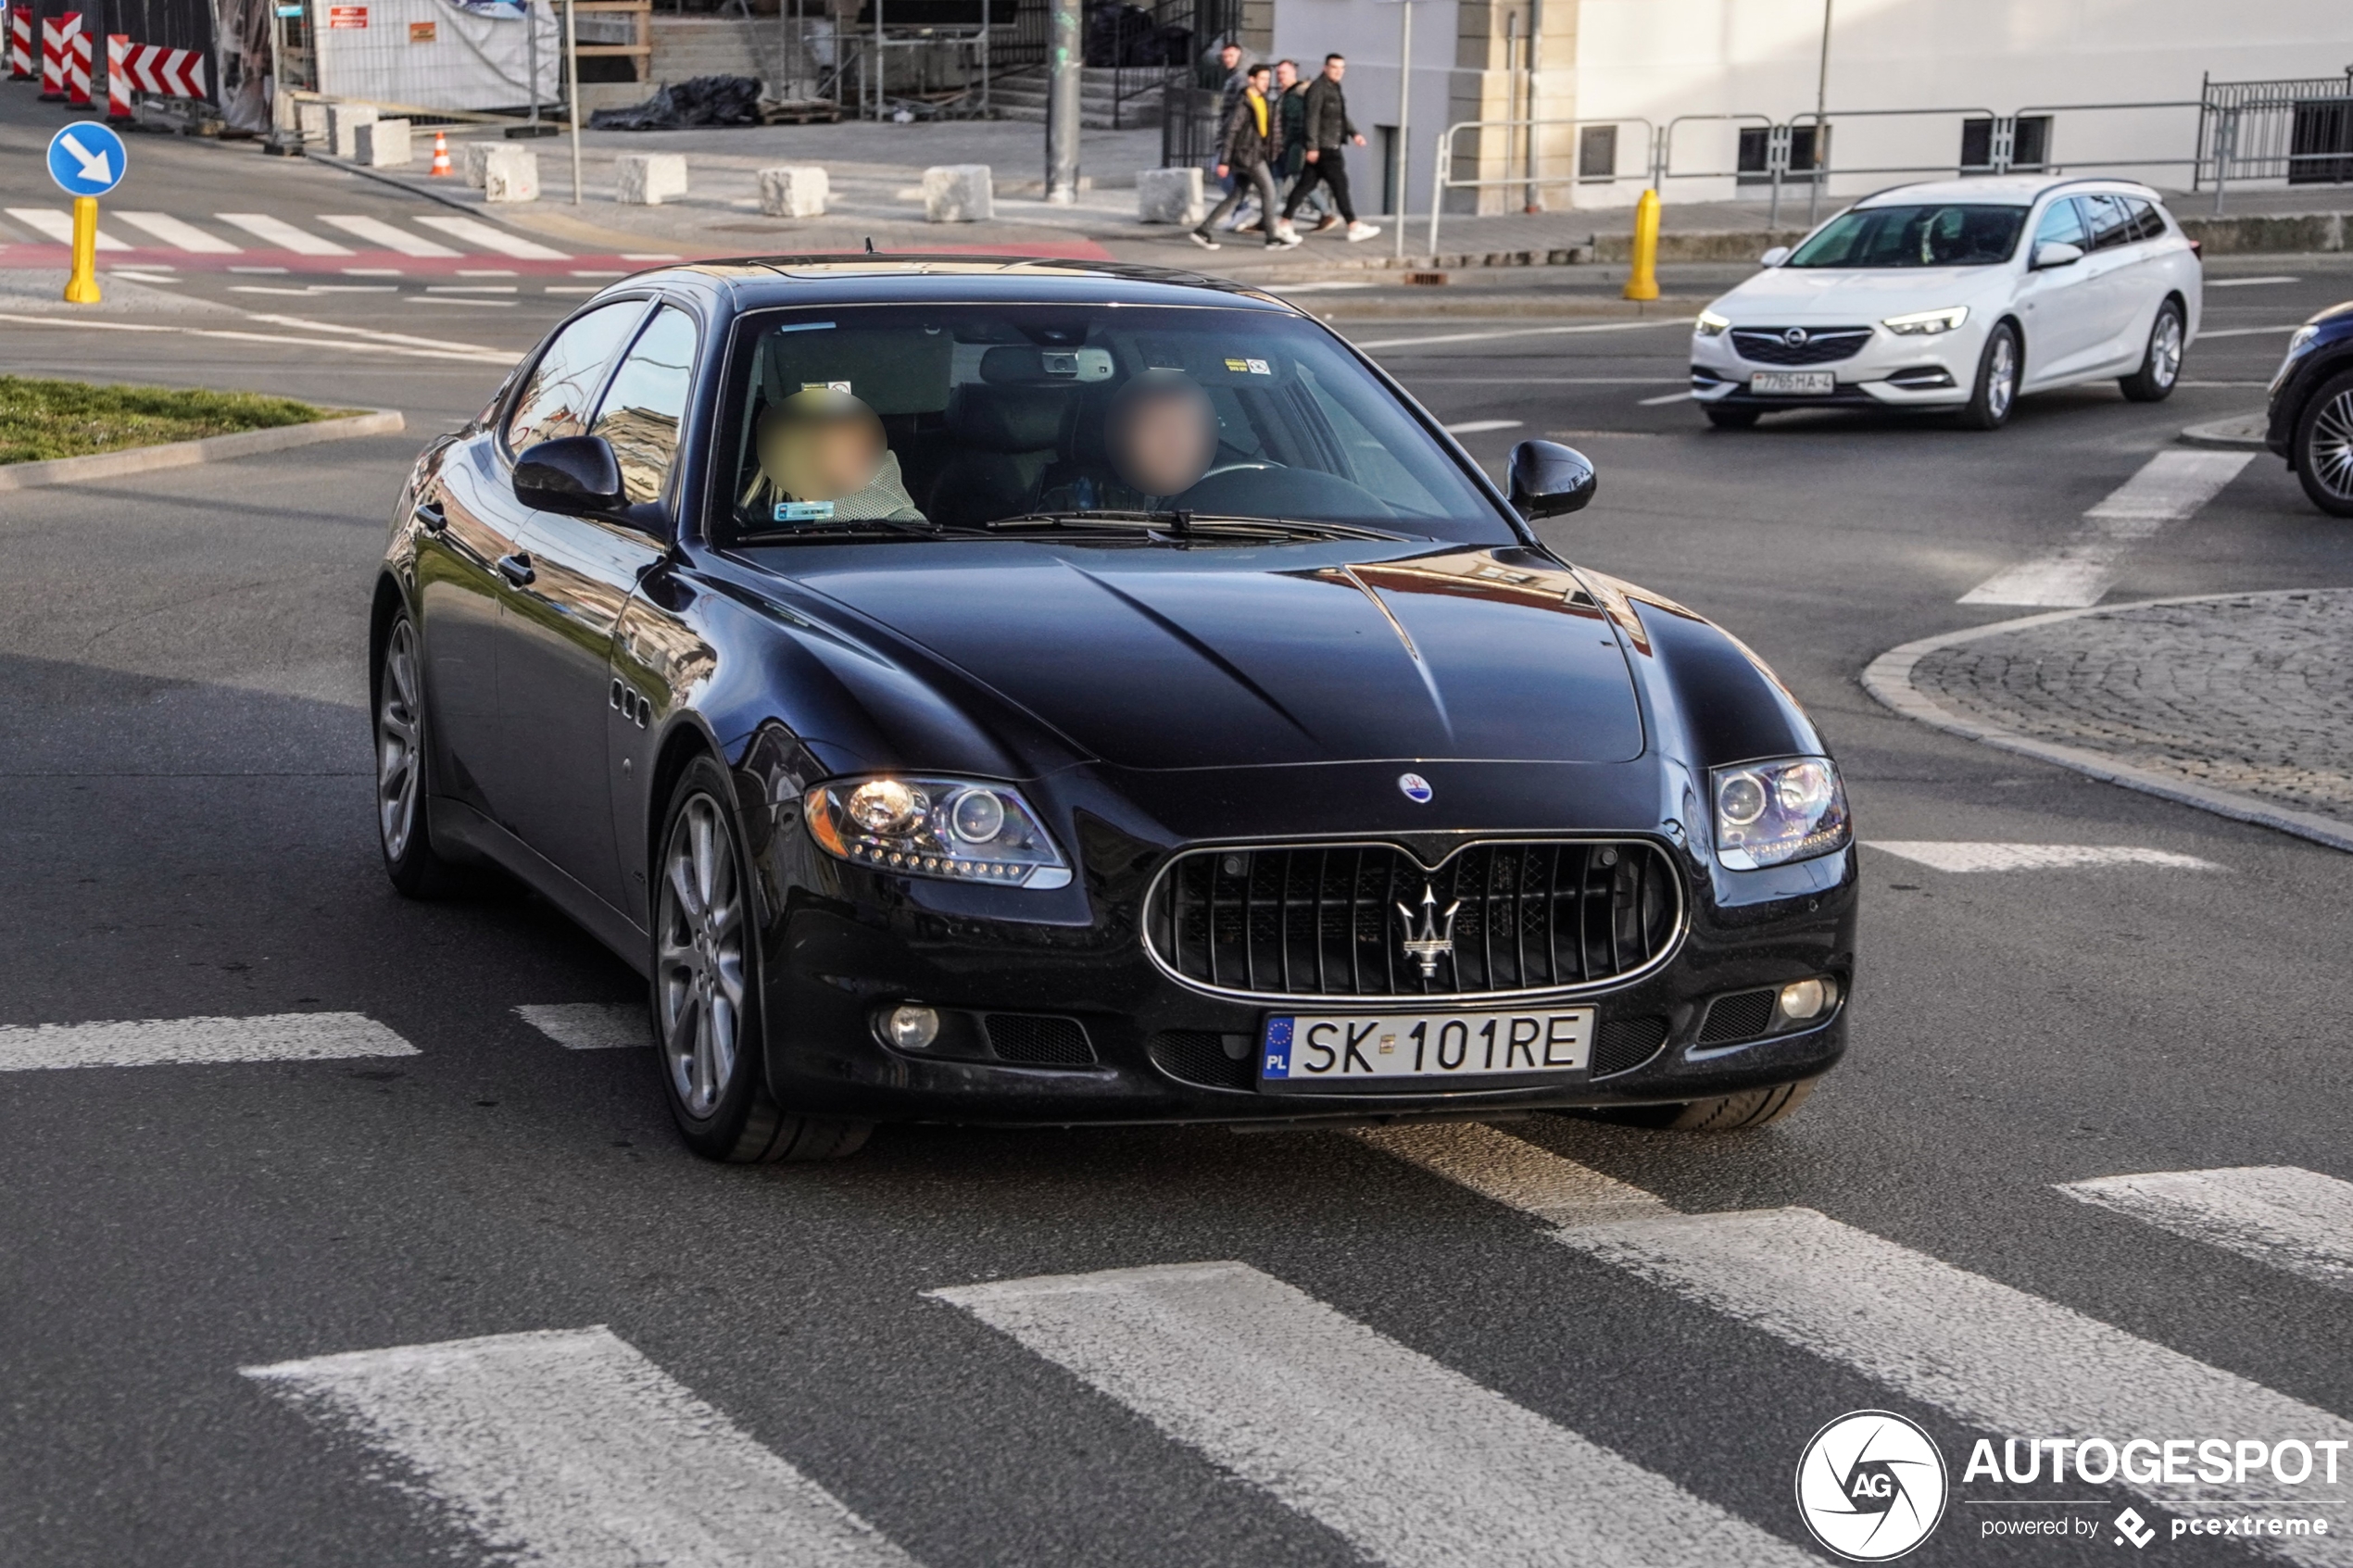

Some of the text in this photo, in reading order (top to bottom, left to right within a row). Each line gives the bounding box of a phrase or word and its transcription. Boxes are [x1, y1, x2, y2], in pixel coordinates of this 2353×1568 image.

[1303, 1015, 1579, 1073] SK 101RE
[1266, 1055, 1287, 1070] PL
